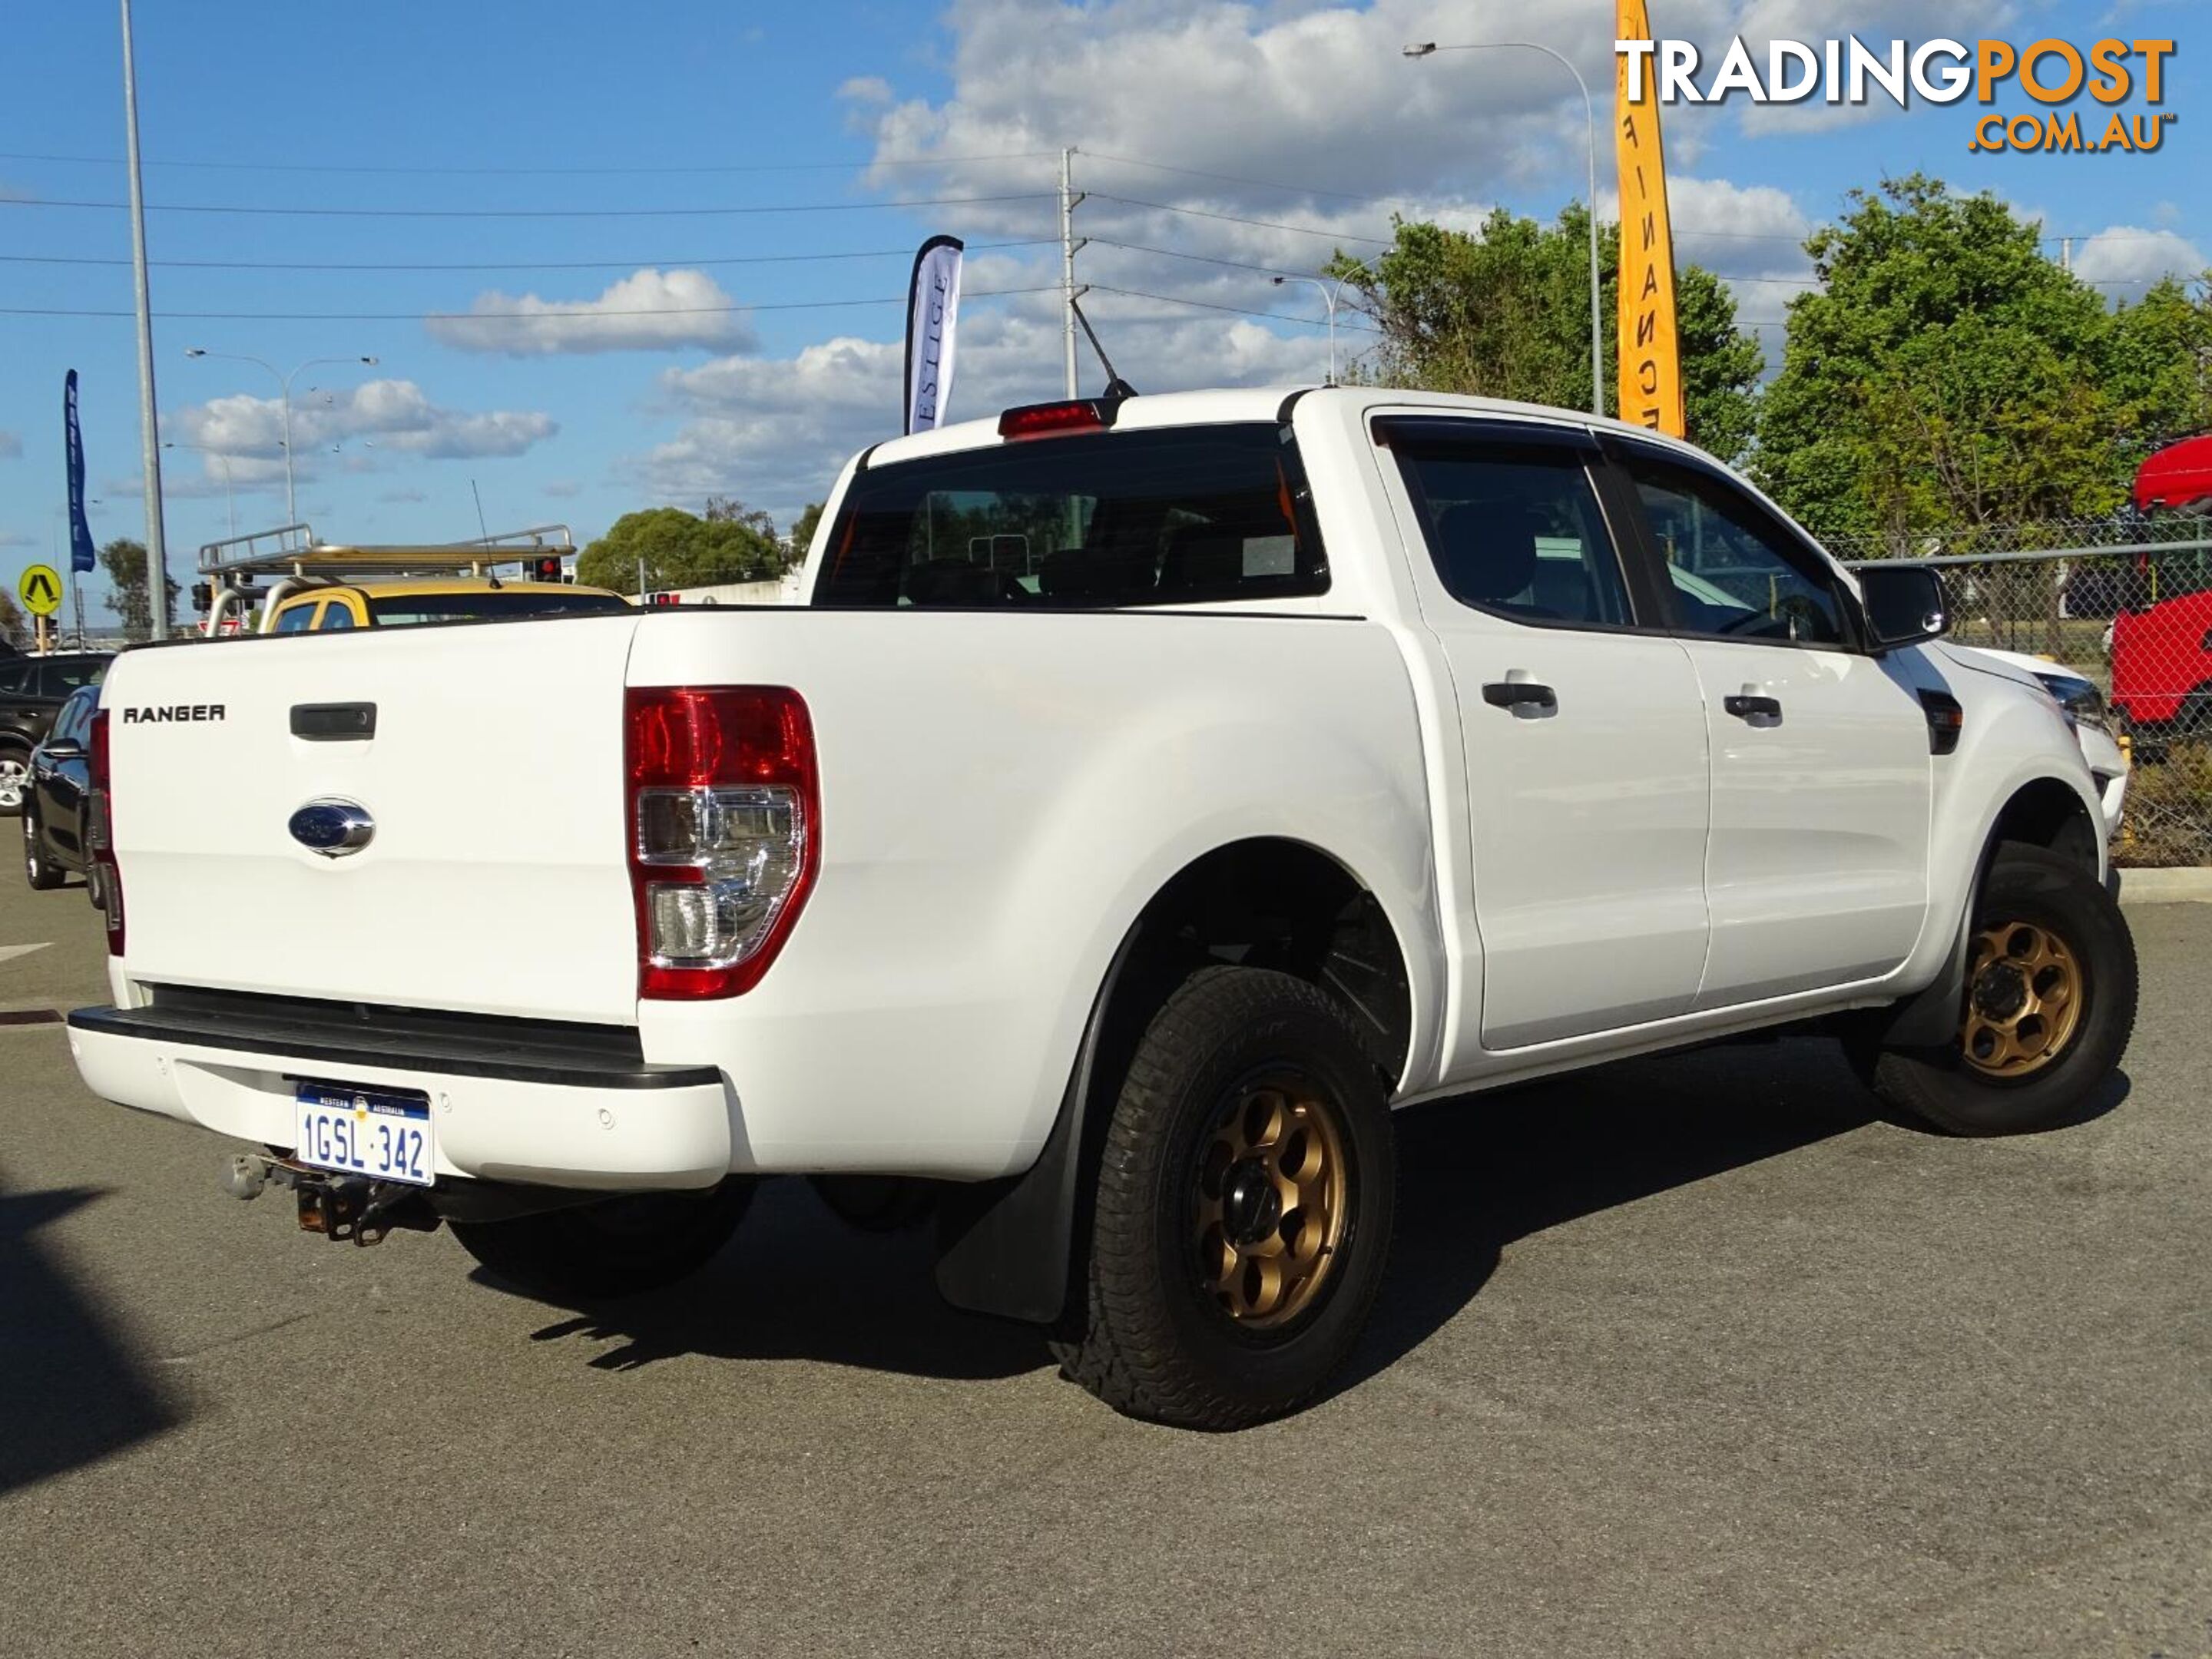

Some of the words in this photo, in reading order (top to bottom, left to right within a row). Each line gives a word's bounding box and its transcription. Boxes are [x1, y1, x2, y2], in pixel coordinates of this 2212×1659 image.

[124, 704, 225, 724] RANGER
[320, 1097, 349, 1108] WESTERN
[373, 1104, 405, 1116] AUSTRALIA
